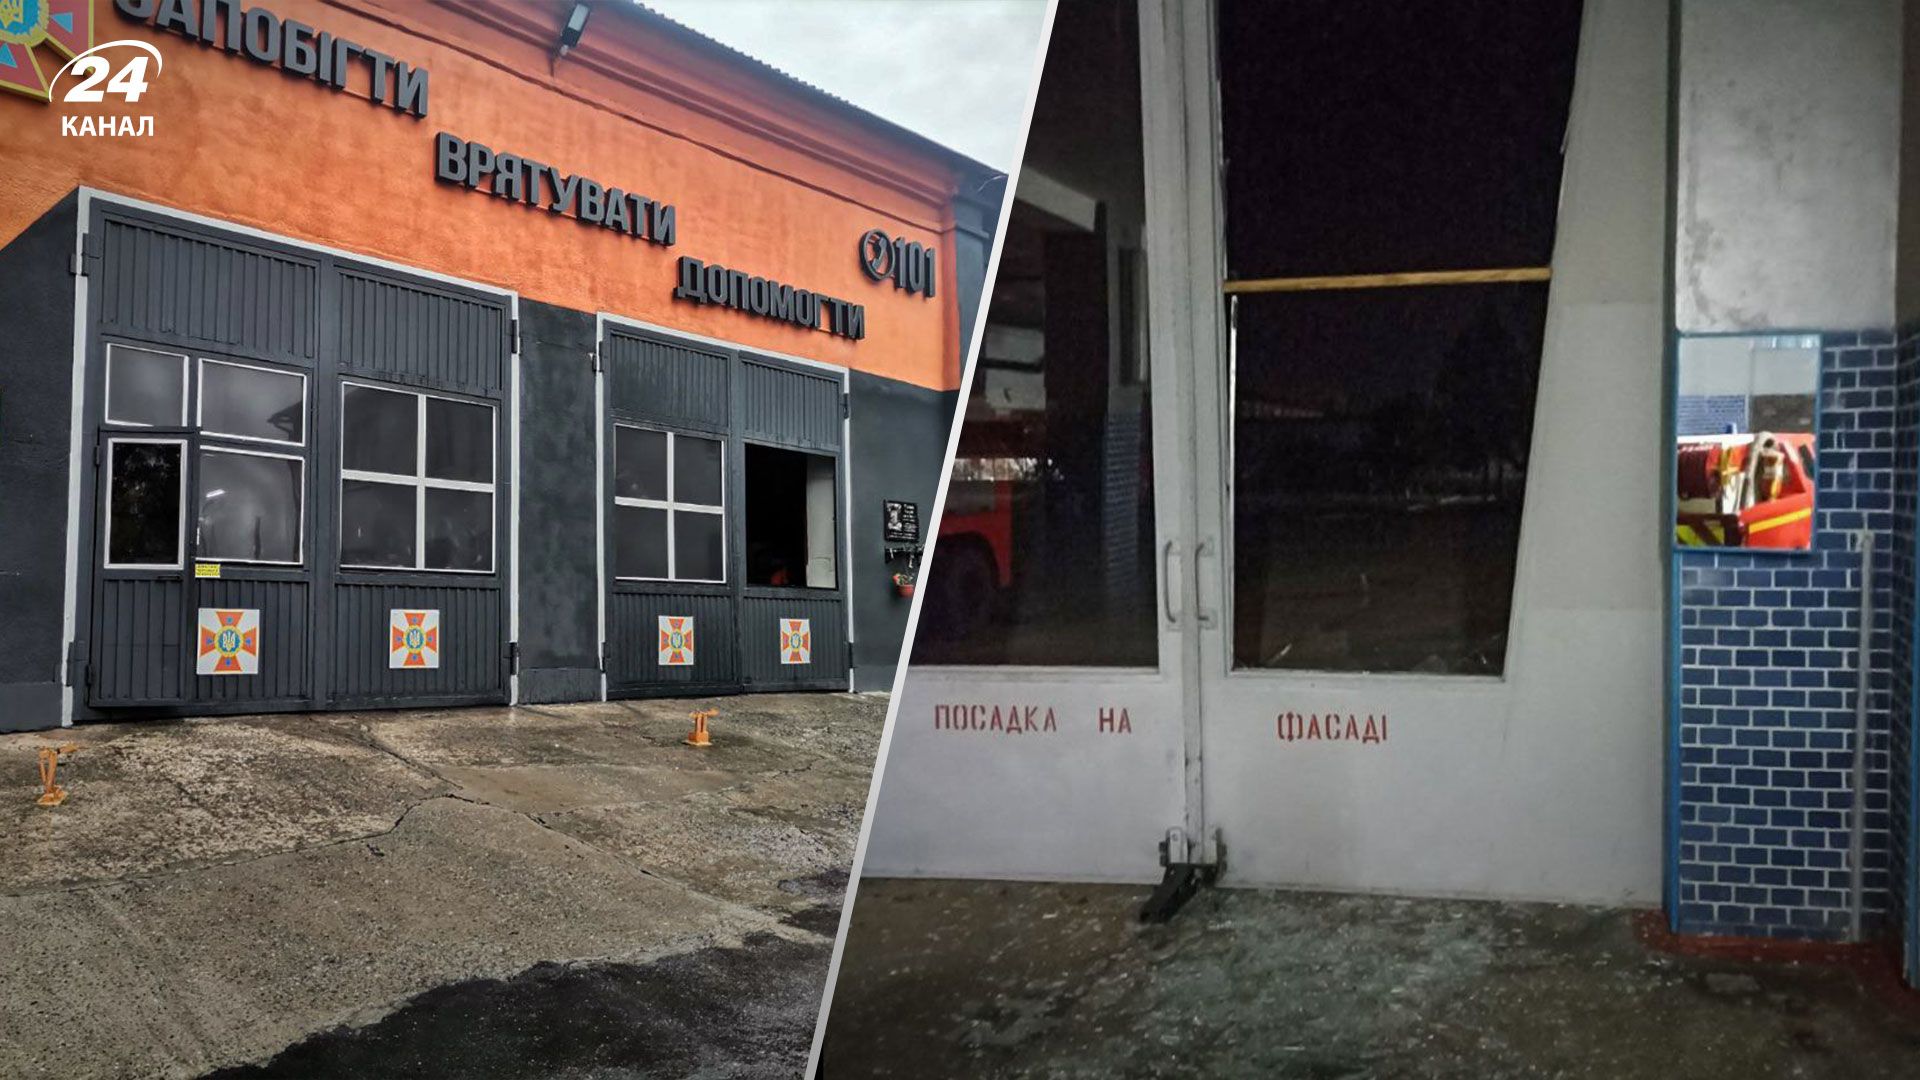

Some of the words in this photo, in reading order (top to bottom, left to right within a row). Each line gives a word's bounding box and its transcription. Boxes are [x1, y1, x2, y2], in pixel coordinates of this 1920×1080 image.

[113, 0, 429, 118] АПОБІГТИ
[436, 131, 676, 246] ВРЯТУВАТИ
[674, 256, 866, 340] ДОПОМОГТИ
[894, 236, 936, 298] 101
[934, 704, 1057, 735] ПОСАДКА
[1098, 706, 1133, 735] НА
[1276, 711, 1389, 744] ФАСАДІ
